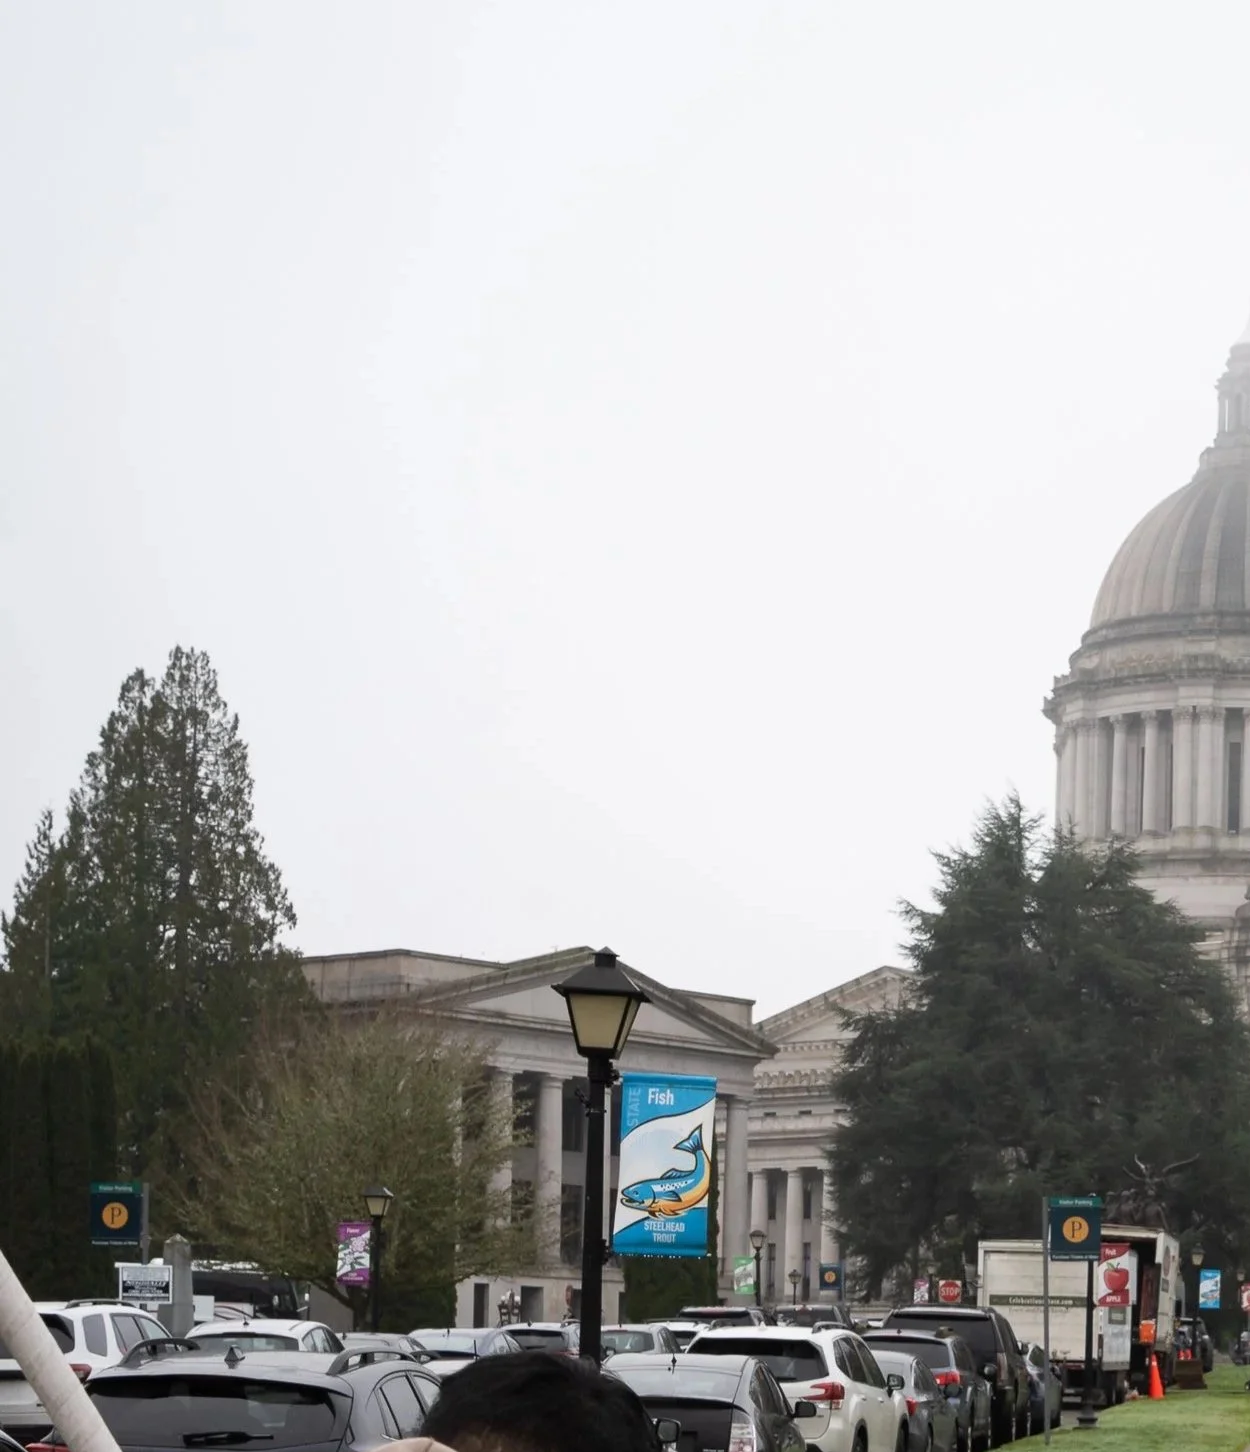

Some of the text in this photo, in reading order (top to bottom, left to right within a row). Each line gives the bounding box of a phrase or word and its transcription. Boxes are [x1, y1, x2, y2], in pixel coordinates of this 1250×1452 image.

[647, 1088, 674, 1106] Fish
[627, 1087, 641, 1127] STATE
[111, 1207, 122, 1225] P
[644, 1221, 685, 1233] STEELHEAD
[1071, 1221, 1082, 1239] P
[653, 1233, 677, 1243] TROUT
[941, 1287, 960, 1297] STOP
[1105, 1295, 1121, 1303] APPLE
